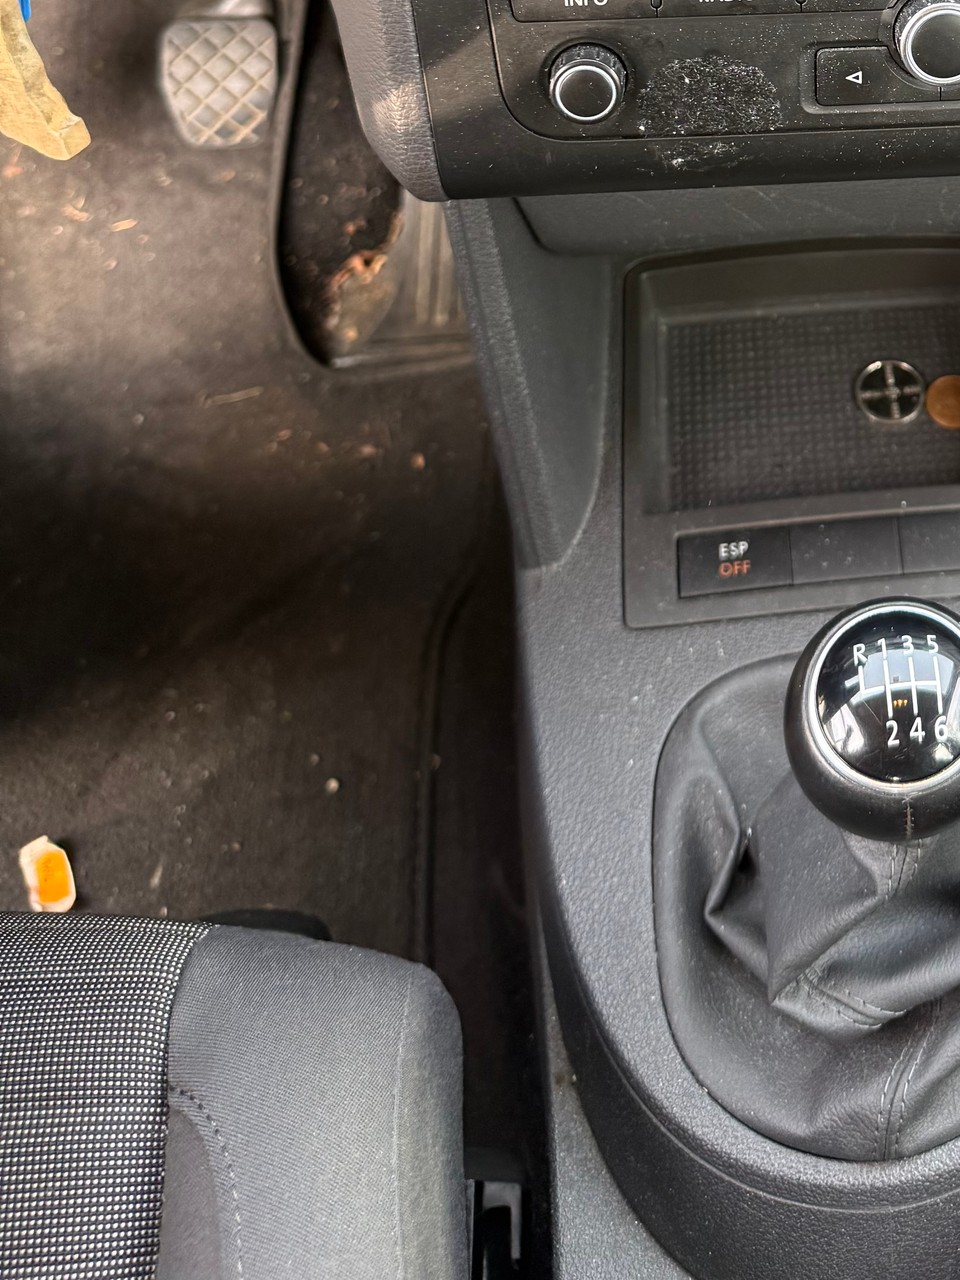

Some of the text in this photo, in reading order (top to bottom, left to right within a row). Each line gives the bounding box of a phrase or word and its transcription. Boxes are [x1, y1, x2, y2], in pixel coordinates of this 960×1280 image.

[719, 540, 749, 560] ESP
[719, 559, 751, 577] OFF
[853, 634, 939, 666] R 1 3 5
[885, 715, 949, 747] 2 4 6
